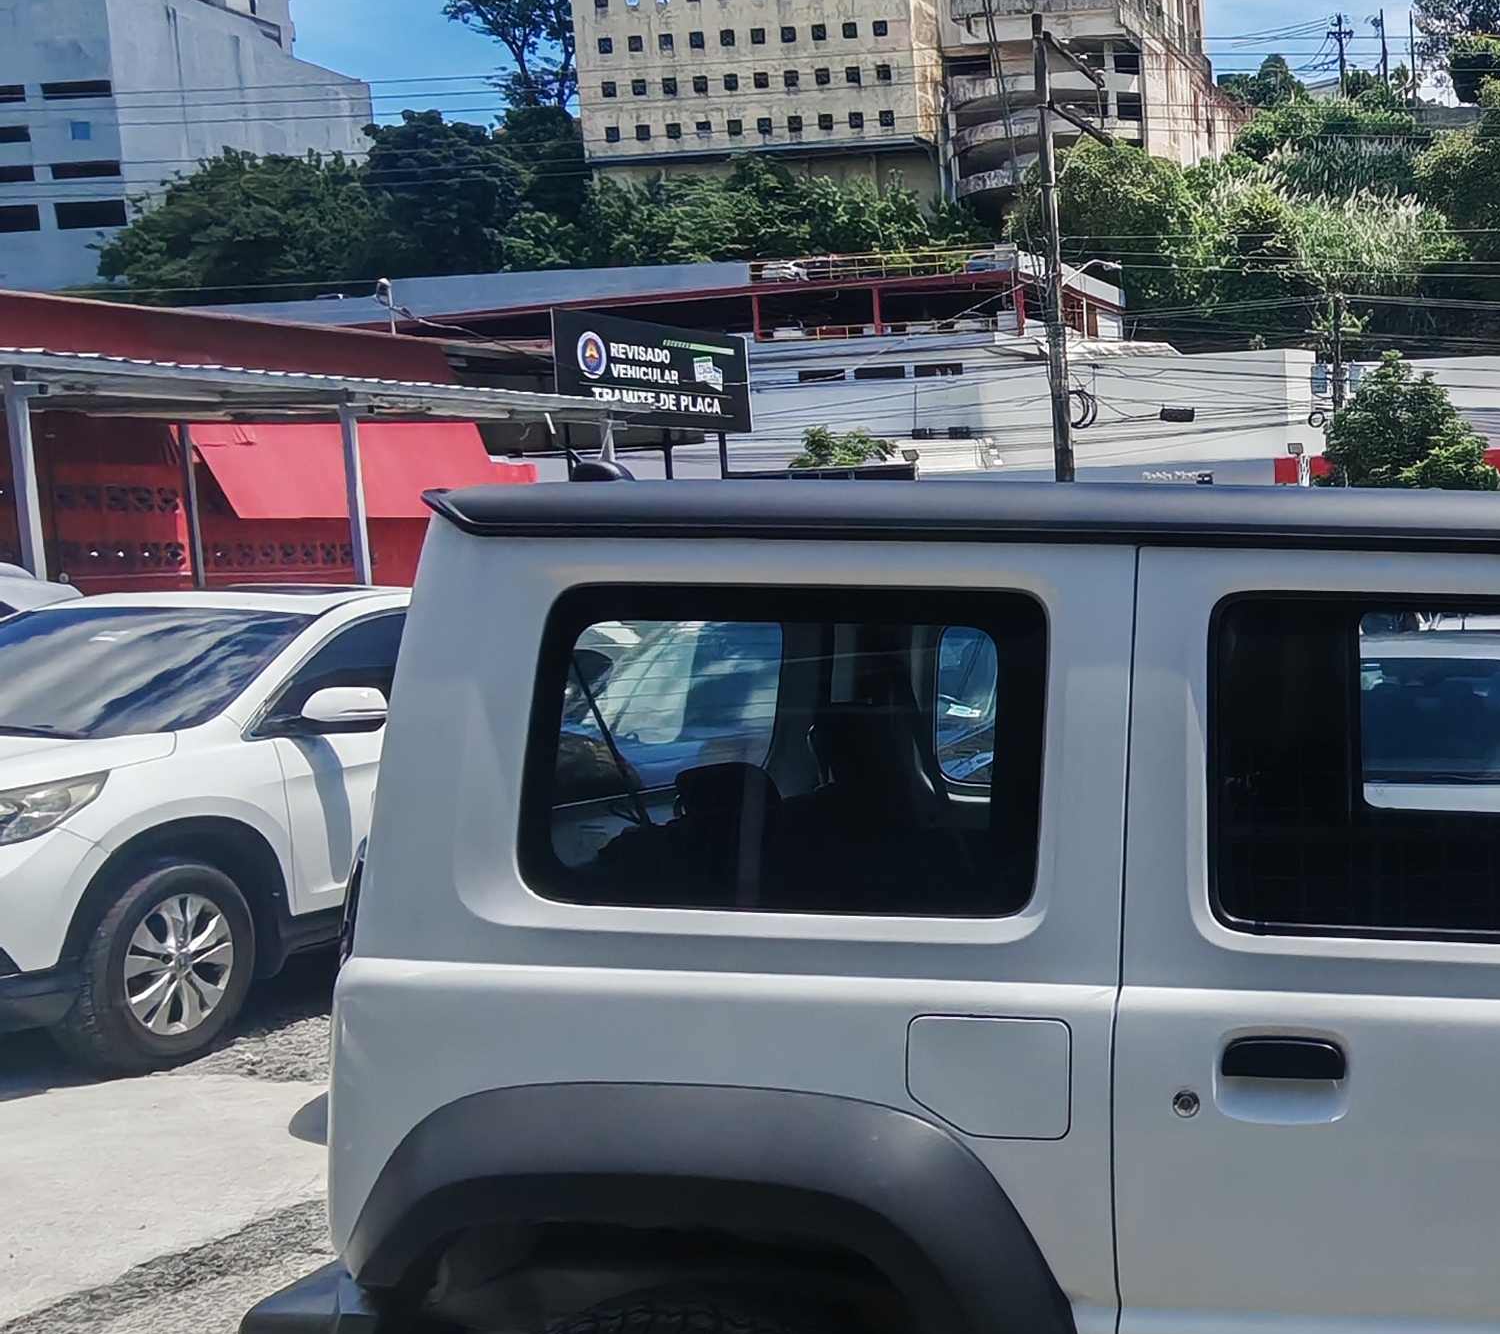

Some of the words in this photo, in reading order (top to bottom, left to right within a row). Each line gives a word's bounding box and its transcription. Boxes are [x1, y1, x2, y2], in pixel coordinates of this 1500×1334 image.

[609, 342, 671, 365] REVISADO
[610, 363, 680, 386] VEHICULAR
[658, 393, 678, 411] DE
[680, 395, 722, 415] PLACA
